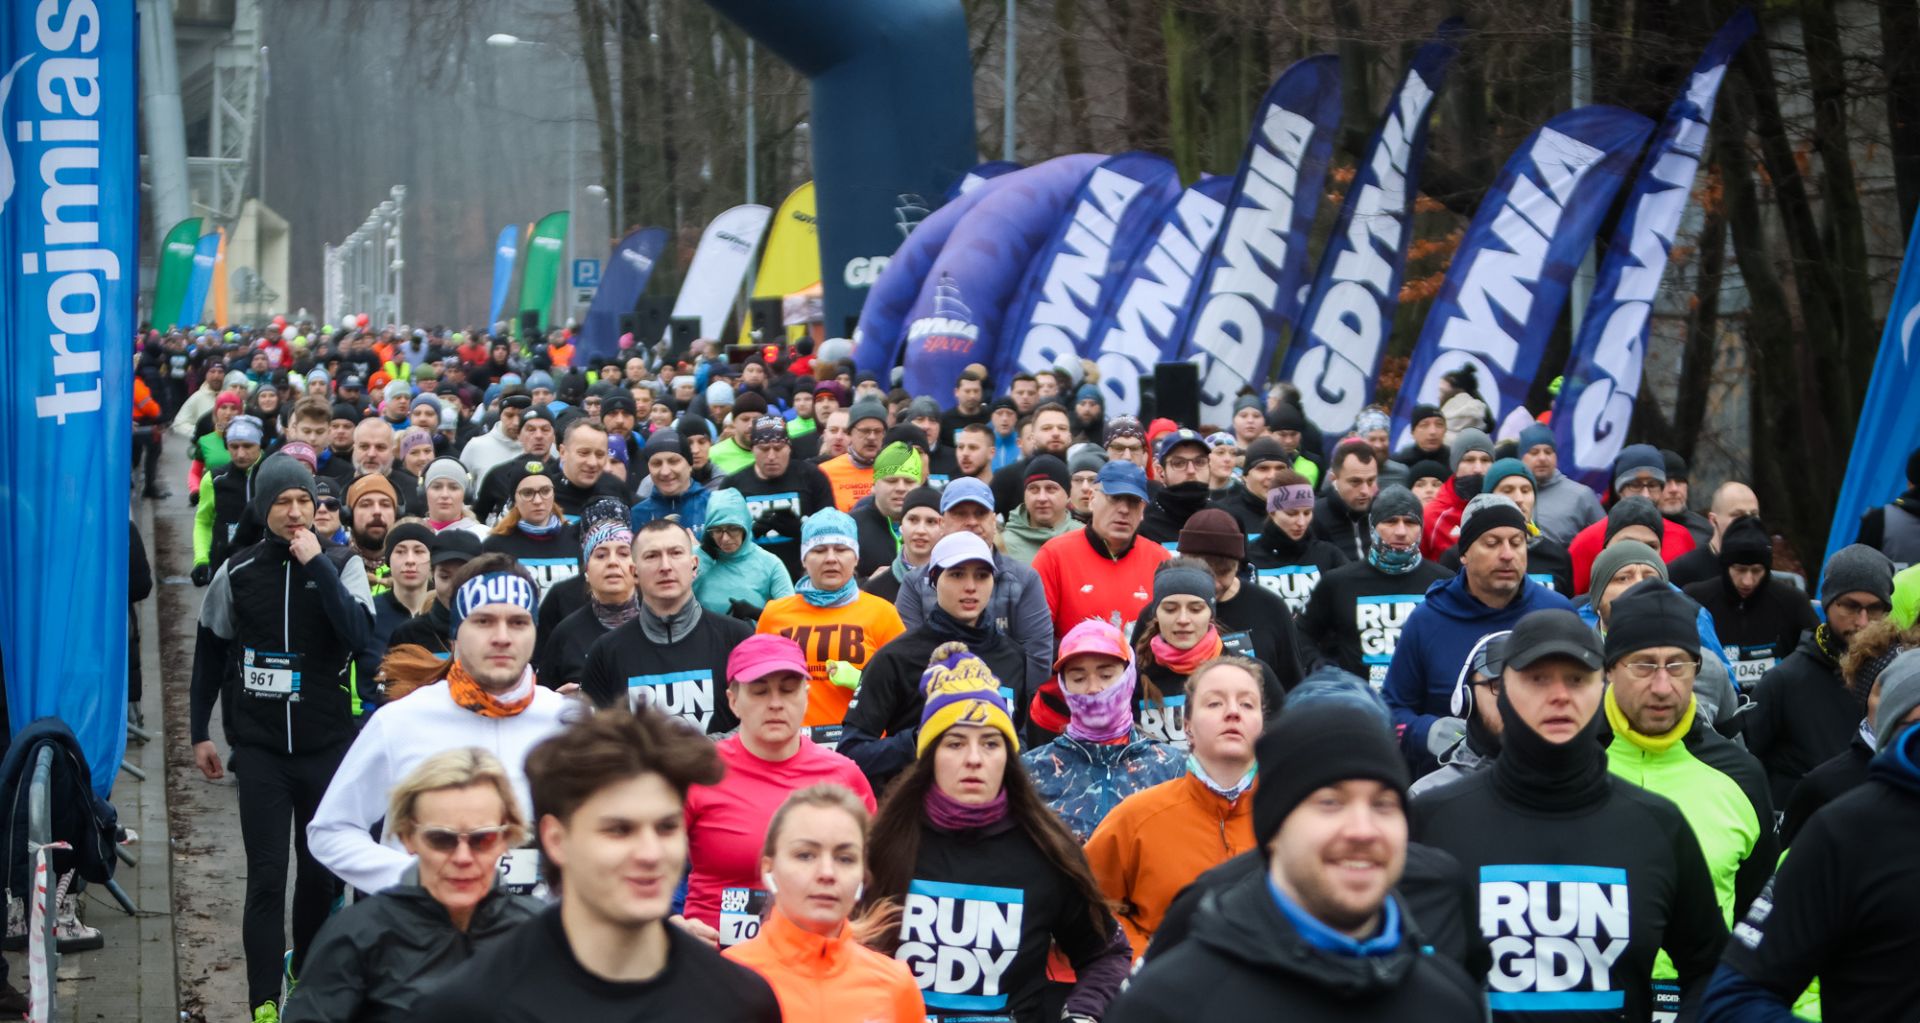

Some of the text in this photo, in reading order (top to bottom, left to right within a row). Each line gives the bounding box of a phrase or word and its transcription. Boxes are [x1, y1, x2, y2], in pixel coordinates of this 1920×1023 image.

[1012, 166, 1144, 392] DYNIA
[1292, 68, 1434, 434] GDYNIA
[1395, 126, 1606, 452] DYNIA
[250, 671, 275, 686] 961
[899, 893, 1024, 950] RUN
[1479, 881, 1629, 938] RUN
[894, 941, 1018, 996] GDY
[1487, 936, 1629, 993] GDY
